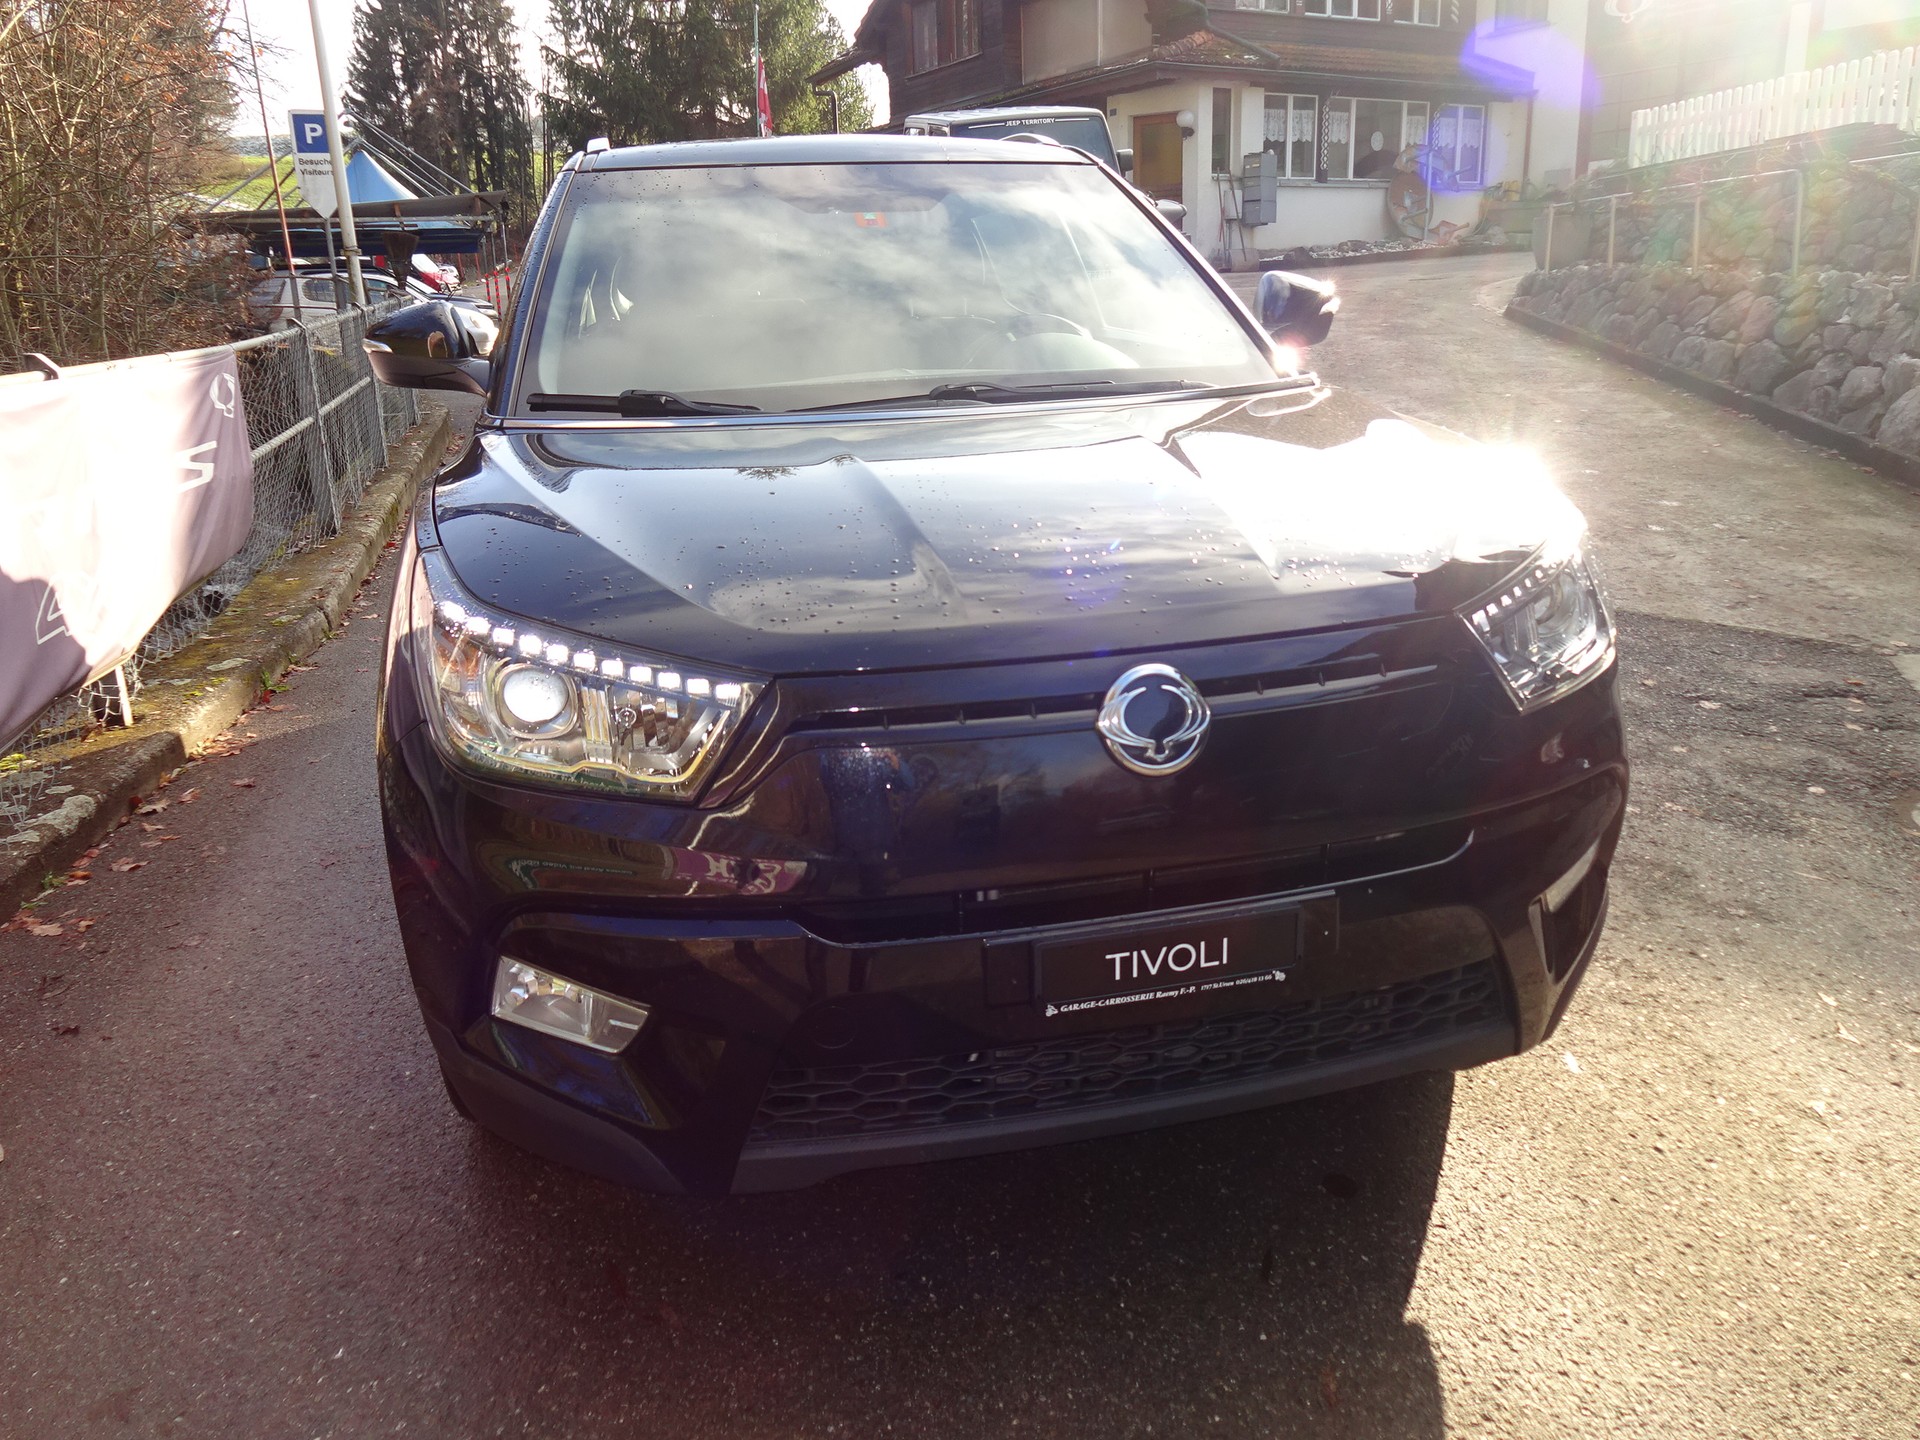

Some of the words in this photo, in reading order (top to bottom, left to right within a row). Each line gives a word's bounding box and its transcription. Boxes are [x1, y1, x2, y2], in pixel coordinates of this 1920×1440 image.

[304, 123, 323, 144] P
[1105, 937, 1228, 981] TIVOLI
[1060, 991, 1155, 1012] GARAGE-CARROSSERIE
